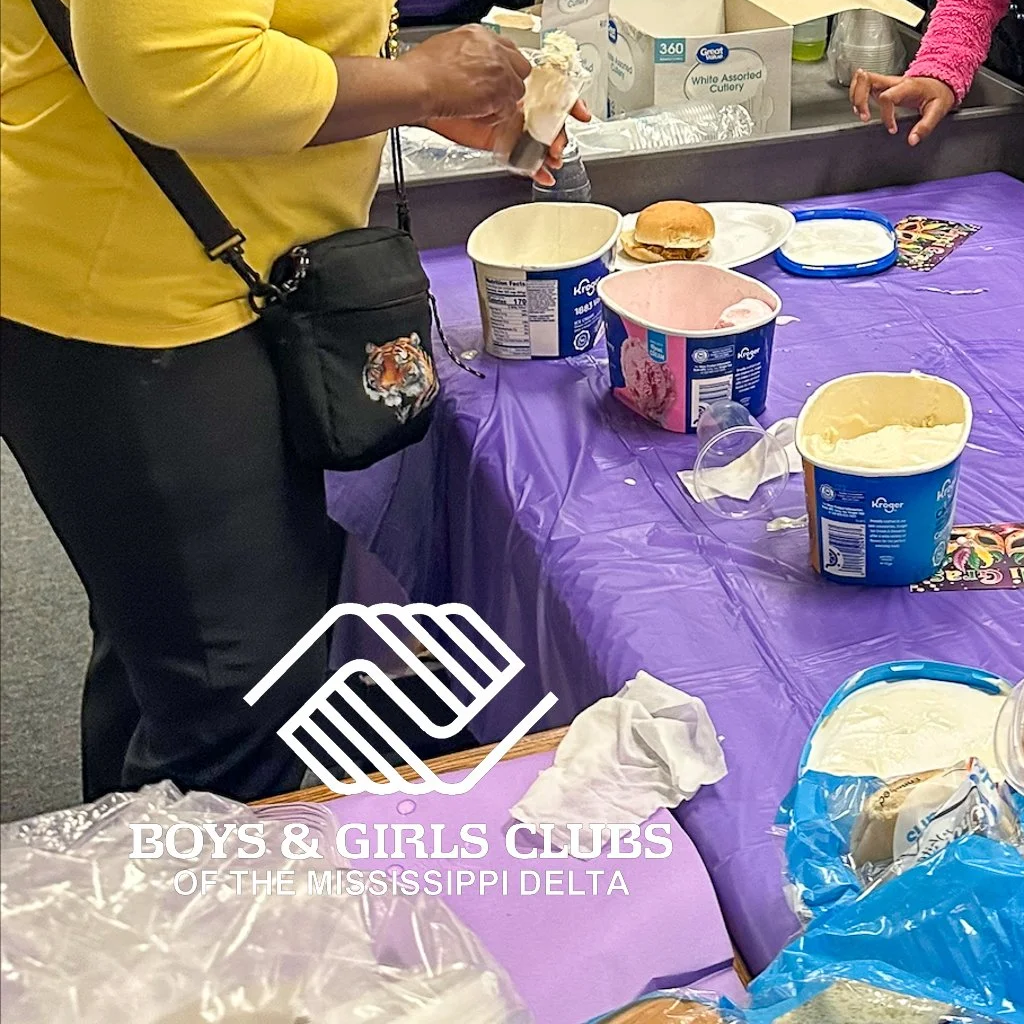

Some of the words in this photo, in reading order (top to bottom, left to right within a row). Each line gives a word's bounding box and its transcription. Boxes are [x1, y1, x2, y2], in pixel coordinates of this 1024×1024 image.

[659, 42, 684, 55] 360
[699, 46, 724, 57] Great
[691, 75, 719, 86] White
[721, 70, 763, 83] Assorted
[709, 81, 745, 94] Cutlery
[737, 347, 760, 360] Kroger
[871, 496, 904, 514] Kroger
